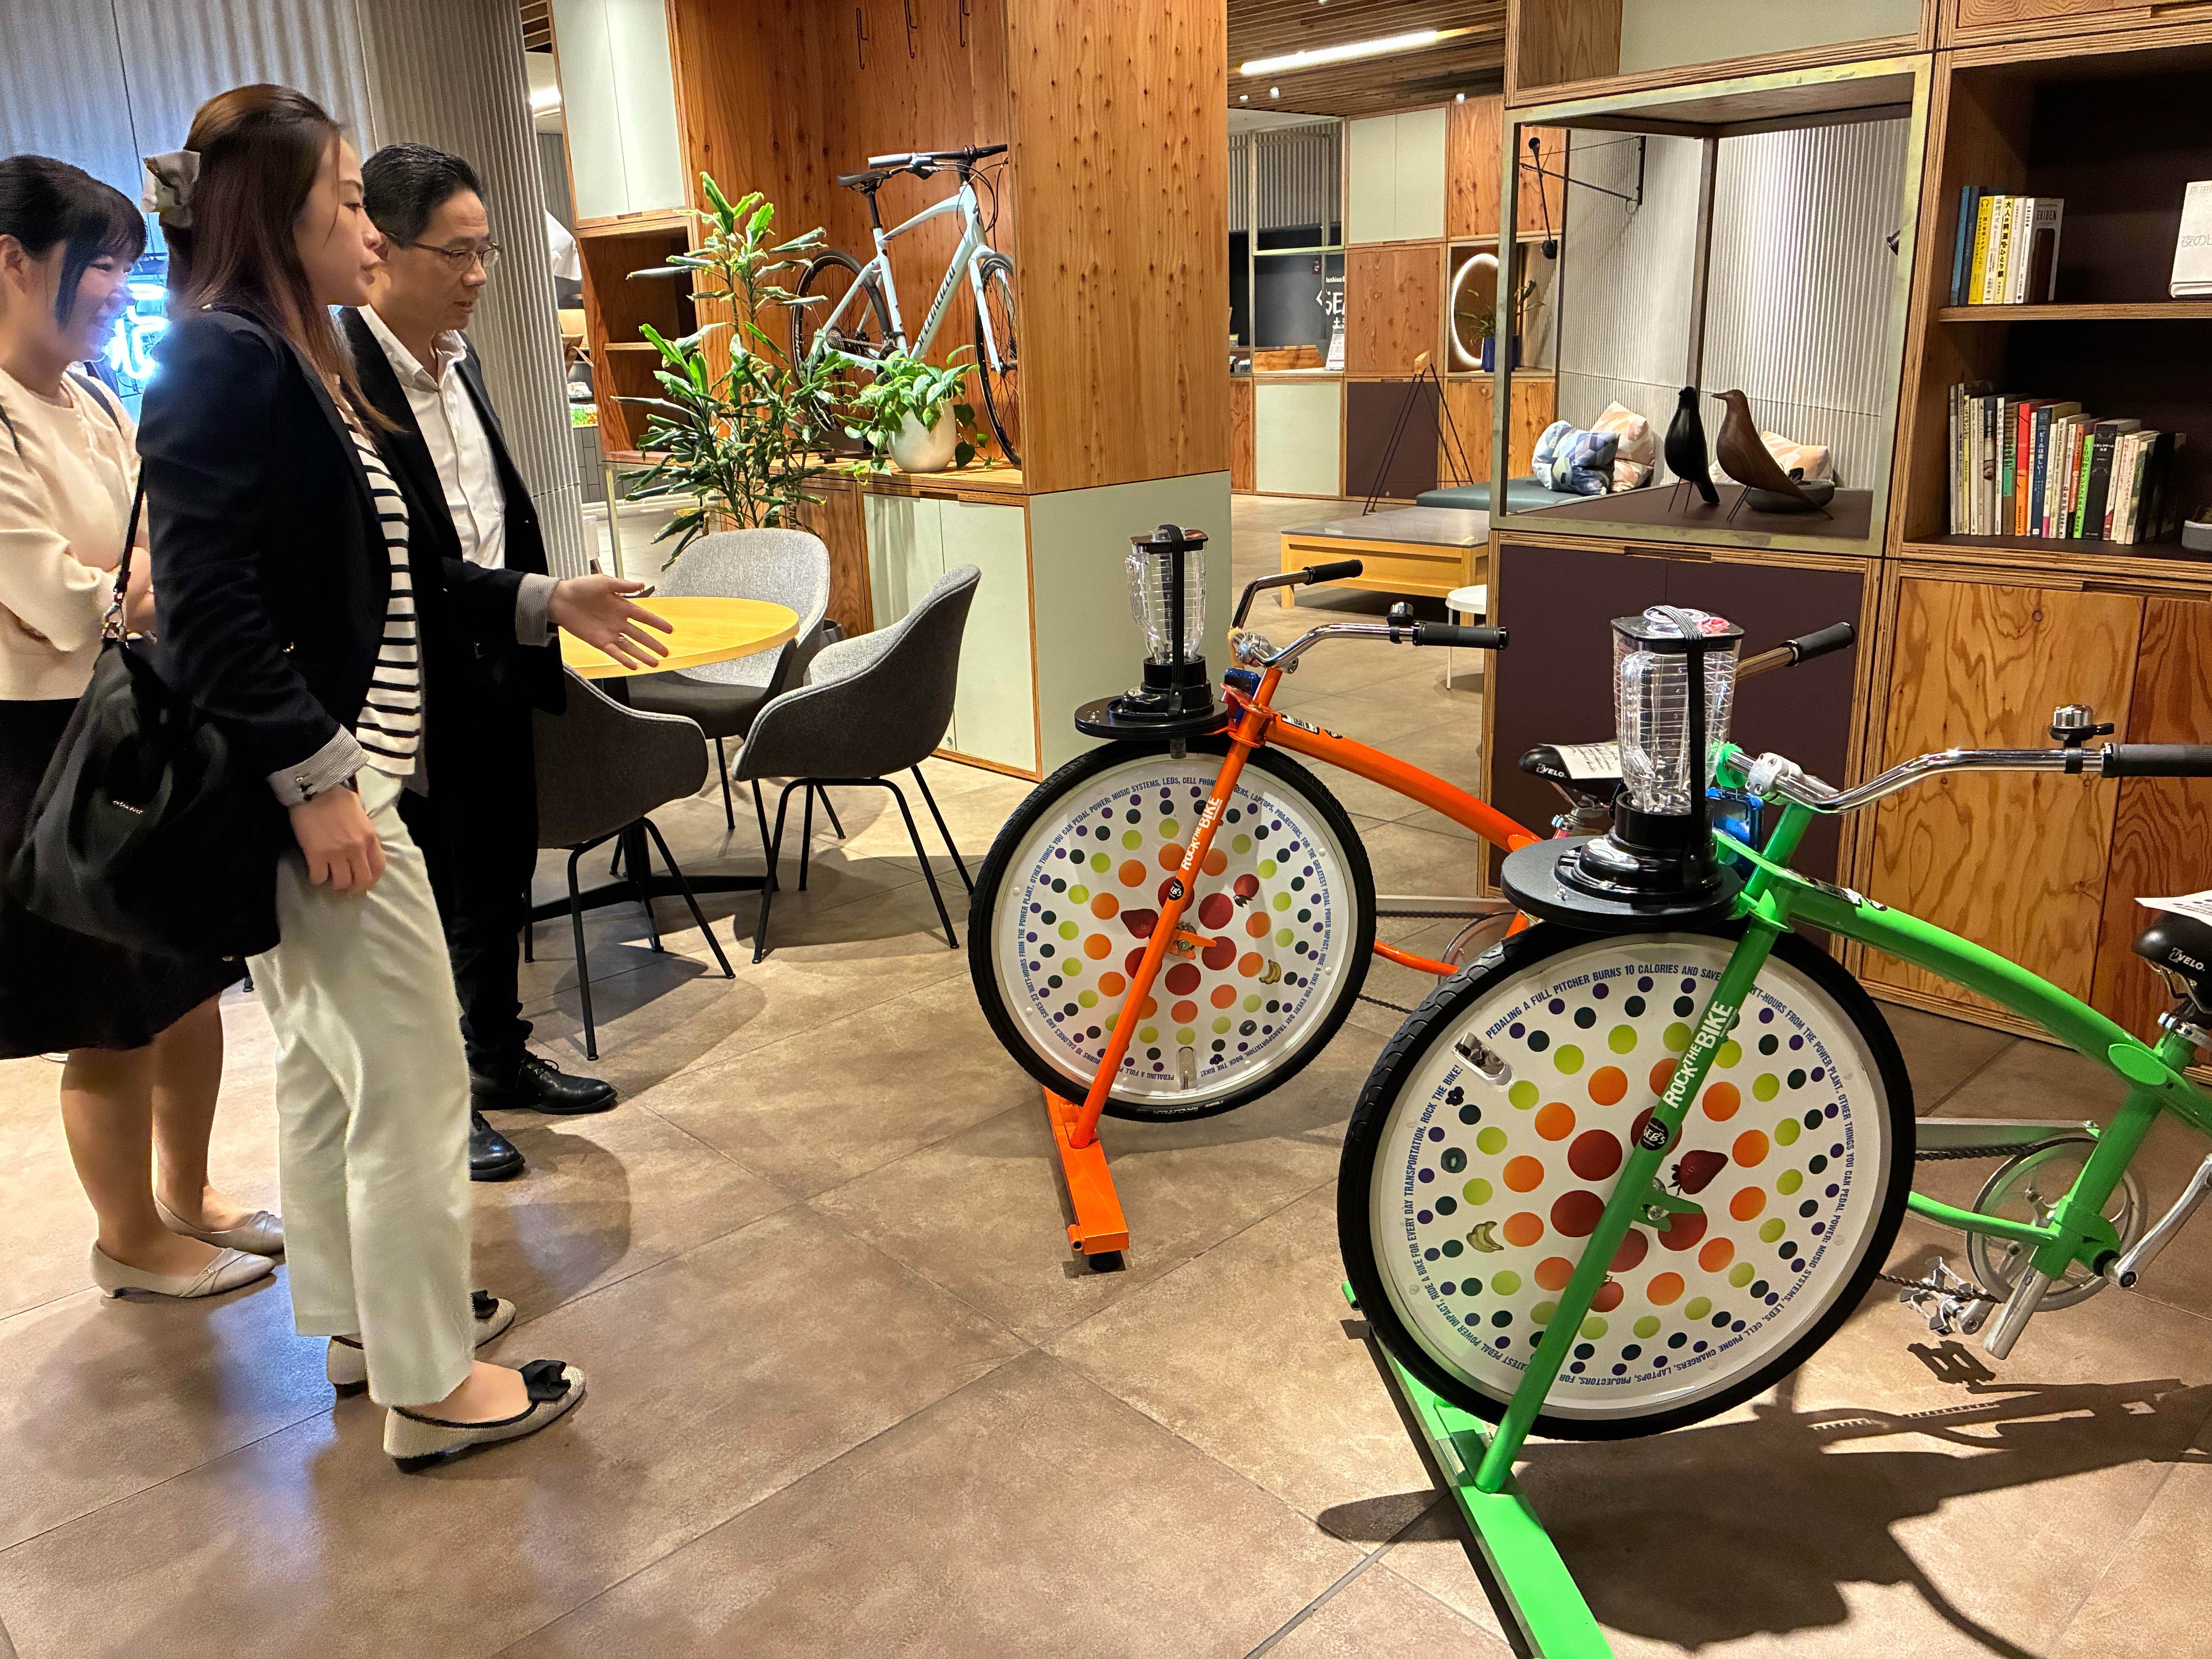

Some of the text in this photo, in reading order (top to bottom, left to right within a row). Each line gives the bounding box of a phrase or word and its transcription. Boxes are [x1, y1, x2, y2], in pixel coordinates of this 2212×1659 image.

[1199, 778, 1216, 786] PHON
[1111, 787, 1130, 800] MUSIC
[1234, 784, 1249, 798] GERS,
[1071, 809, 1090, 826] PEDAL
[1061, 823, 1073, 835] CAN
[1181, 840, 1200, 871] ROCK
[1192, 825, 1202, 841] THE
[1199, 795, 1220, 829] BIKE
[1052, 833, 1063, 845] YOU
[1300, 837, 1310, 848] FOR
[1039, 844, 1055, 864] THINGS
[1307, 848, 1317, 859] THE
[1029, 864, 1042, 883] OTHER
[1312, 859, 1328, 887] GREATEST
[1321, 888, 1331, 907] PEDAL
[1019, 906, 1028, 926] POWER
[1317, 953, 1326, 966] RIDE
[1020, 958, 1035, 993] WATT-HOURS
[1592, 966, 1621, 981] BURNS
[1625, 964, 1634, 975] 10
[1638, 963, 1680, 974] CALORIES
[1681, 965, 1699, 976] AND
[1700, 968, 1722, 981] SAVE
[1309, 972, 1319, 986] BIKE
[1553, 973, 1590, 994] PITCHER
[1030, 993, 1039, 1002] 23
[1304, 986, 1313, 998] FOR
[1530, 988, 1553, 1006] FULL
[1035, 1001, 1049, 1018] SAVES
[1293, 998, 1307, 1015] EVERY
[1521, 1000, 1531, 1010] A
[1046, 1017, 1057, 1029] AND
[1285, 1014, 1295, 1025] DAY
[1484, 1006, 1523, 1039] PEDALING
[1784, 1009, 1806, 1030] FROM
[1054, 1028, 1077, 1050] CALORIES
[1801, 1026, 1817, 1042] THE
[1082, 1051, 1101, 1065] BURNS
[1228, 1054, 1244, 1066] ROCK
[1663, 1067, 1698, 1109] ROCK
[1683, 1043, 1702, 1066] THE
[1695, 1001, 1734, 1049] BIKE
[1812, 1041, 1834, 1067] POWER
[1125, 1068, 1139, 1076] FULL
[1216, 1062, 1227, 1071] THE
[1442, 1064, 1463, 1087] BIKE!
[1826, 1066, 1844, 1093] PLANT.
[1431, 1084, 1448, 1101] THE
[1419, 1101, 1437, 1123] ROCK
[1838, 1093, 1851, 1120] OTHER
[1844, 1121, 1854, 1150] THINGS
[1404, 1125, 1427, 1196] TRANSPORTATION.
[1846, 1152, 1854, 1167] YOU
[1843, 1170, 1852, 1185] CAN
[1403, 1199, 1413, 1215] DAY
[1835, 1188, 1849, 1213] PEDAL
[1404, 1216, 1417, 1242] EVERY
[1822, 1214, 1841, 1243] POWER:
[1408, 1242, 1420, 1258] FOR
[1808, 1244, 1827, 1268] MUSIC
[1413, 1258, 1427, 1276] BIKE
[1424, 1282, 1440, 1301] RIDE
[1781, 1268, 1812, 1304] SYSTEMS,
[1434, 1298, 1461, 1328] IMPACT,
[1762, 1302, 1785, 1324] LEDS,
[1456, 1324, 1482, 1347] POWER
[1744, 1321, 1763, 1337] CELL
[1479, 1342, 1503, 1361] PEDAL
[1717, 1334, 1743, 1353] PHONE
[1502, 1356, 1530, 1371] EATEST
[1673, 1348, 1717, 1372] CHARGERS,
[1558, 1374, 1575, 1383] FOR
[1577, 1376, 1631, 1385] PROJECTORS.
[1635, 1367, 1672, 1382] LAPTOPS,
